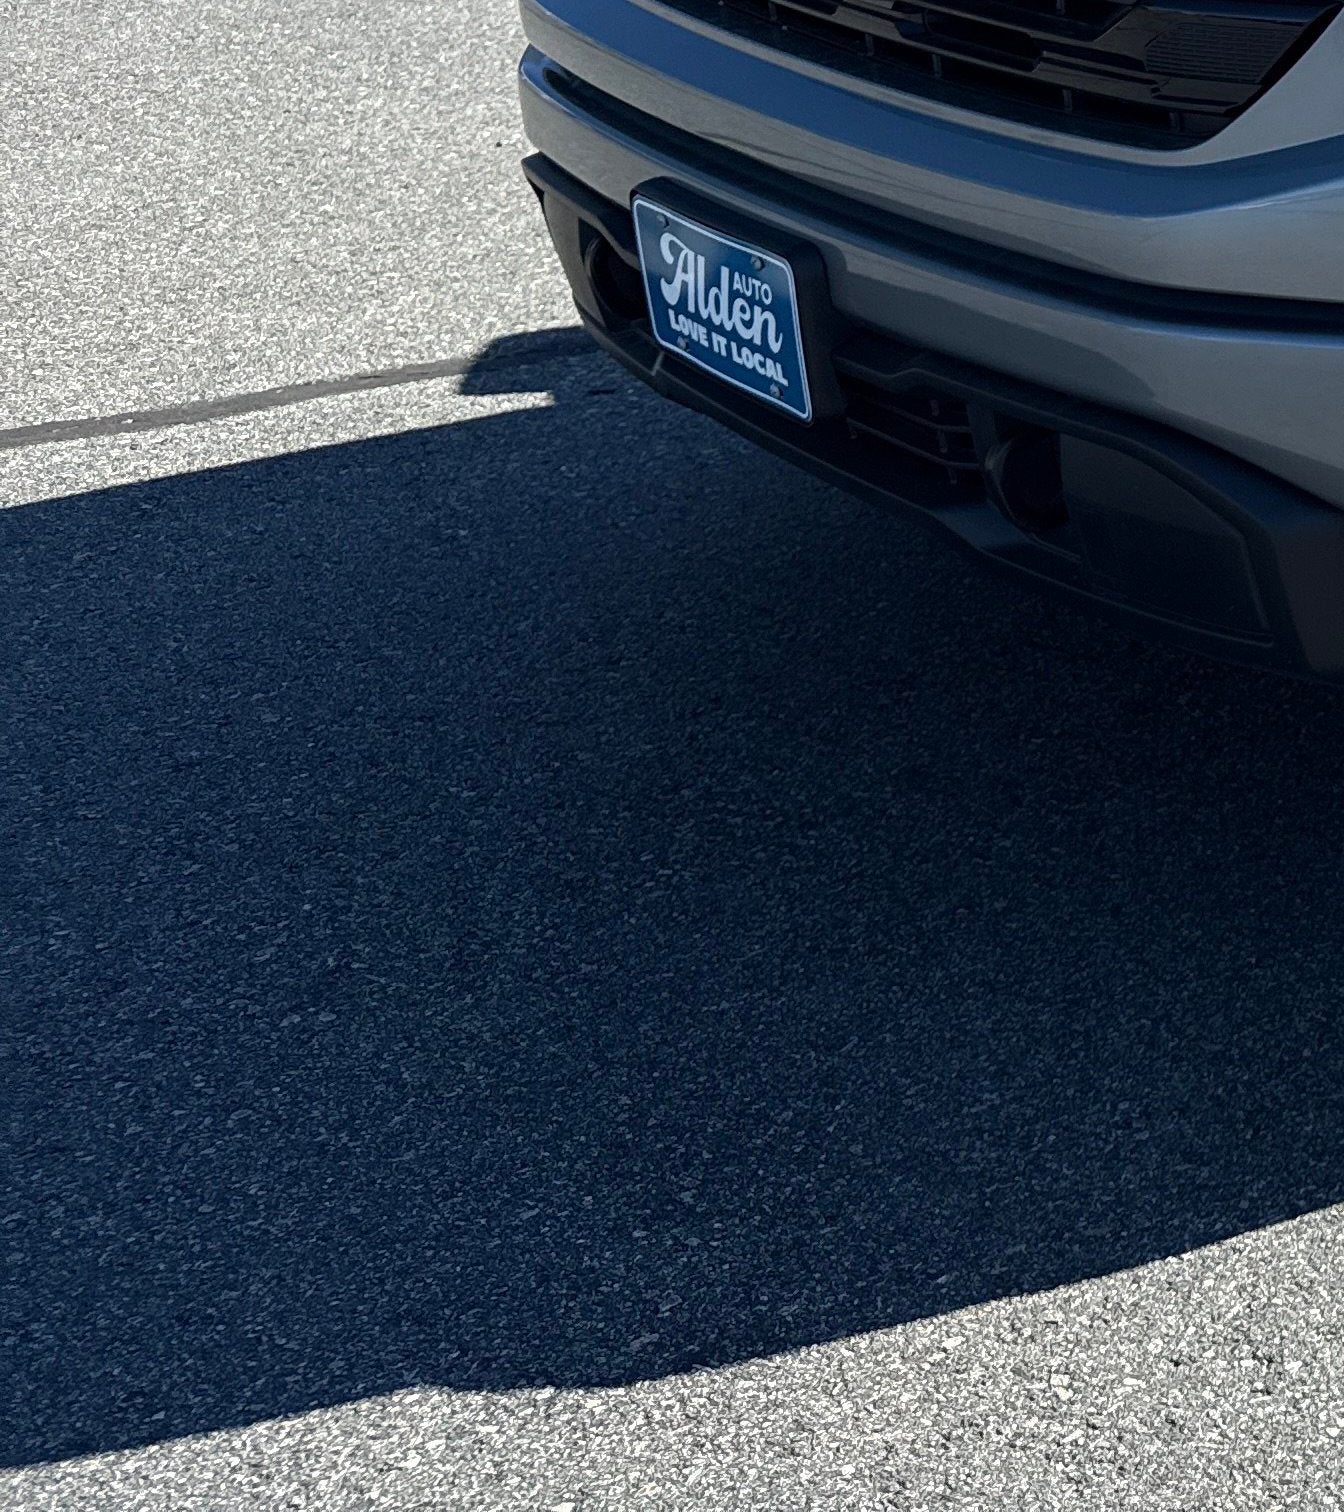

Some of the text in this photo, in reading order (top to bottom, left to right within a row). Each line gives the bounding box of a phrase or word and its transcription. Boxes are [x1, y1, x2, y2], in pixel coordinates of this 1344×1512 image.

[660, 232, 783, 354] Alden
[733, 271, 773, 305] AUTO
[668, 308, 789, 388] LOVE IT LOCAL
